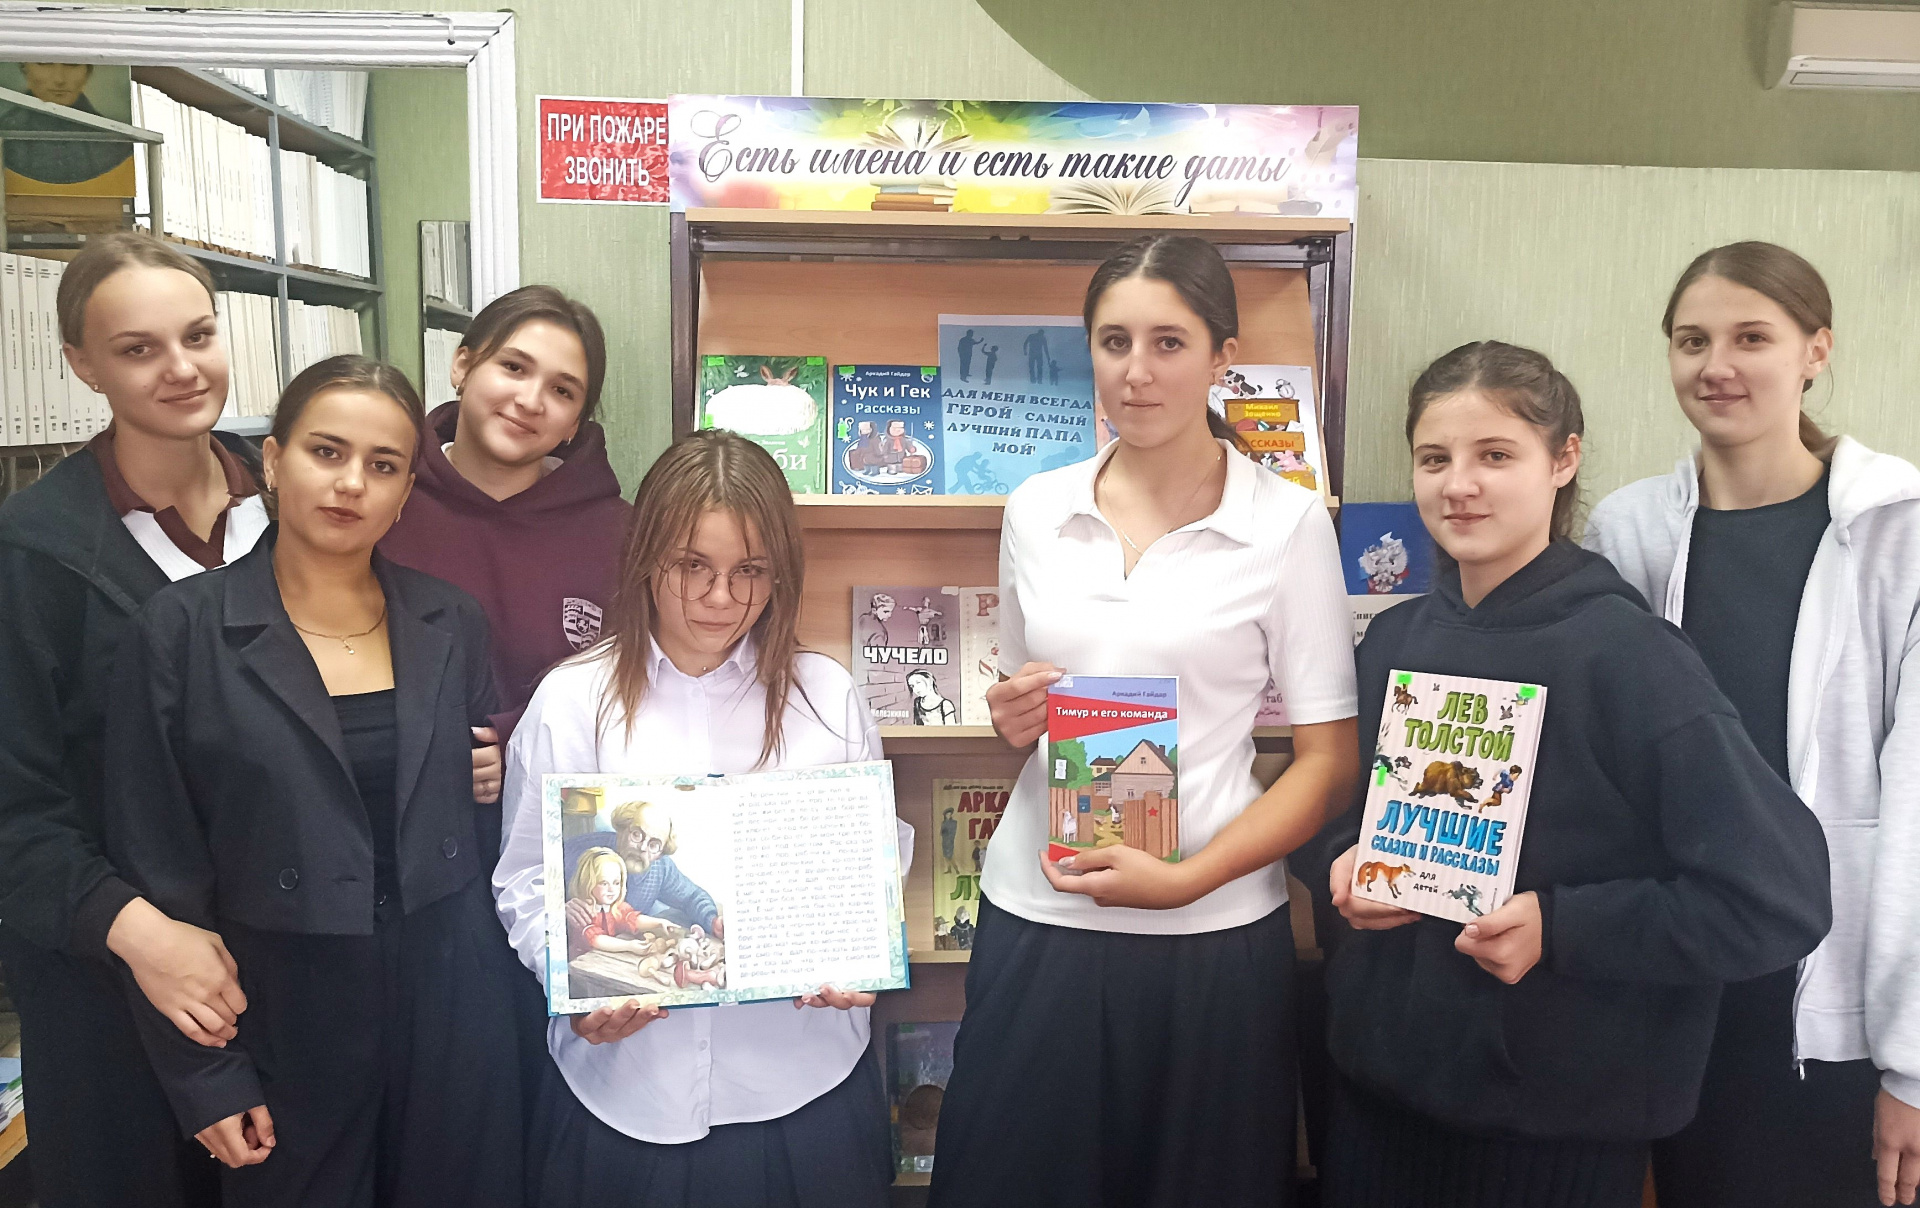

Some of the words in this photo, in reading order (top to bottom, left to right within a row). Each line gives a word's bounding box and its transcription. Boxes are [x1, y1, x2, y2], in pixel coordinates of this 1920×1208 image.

[547, 113, 584, 143] ПРИ
[590, 115, 667, 145] ПОЖАРЕ
[691, 110, 799, 183] Есть
[809, 147, 931, 175] имена
[940, 150, 966, 175] и
[974, 150, 1051, 178] есть
[1059, 151, 1177, 180] такие
[1175, 152, 1291, 207] даты
[565, 156, 650, 186] ЗВОНИТЬ
[845, 384, 879, 400] Чук
[883, 386, 895, 397] и
[900, 384, 931, 399] Гек
[942, 387, 978, 399] ДЛЯ
[981, 391, 1026, 404] МЕНЯ
[1029, 396, 1093, 410] ВСЕГДА
[855, 403, 920, 415] Рассказы
[946, 402, 1013, 420] ГЕРОЙ
[1025, 412, 1087, 426] САМЫЙ
[947, 422, 1022, 438] ЛУЧШИЙ
[1025, 427, 1083, 443] ПАПА
[1250, 439, 1295, 448] ССКАЗЫ
[992, 441, 1036, 456] МОЙ!
[863, 646, 949, 665] ЧУЧЕЛО
[1056, 706, 1089, 719] Тимур
[1101, 710, 1118, 718] его
[1120, 710, 1168, 721] команда
[1437, 691, 1489, 725] ЛЕВ
[1404, 718, 1515, 762] ТОЛСТОЙ
[957, 791, 1010, 813] АРКА
[1376, 800, 1507, 856] ЛУЧШИЕ
[1371, 834, 1417, 859] СКАЗКИ
[1418, 844, 1429, 861] И
[1429, 846, 1500, 876] РАССКАЗЫ
[1413, 883, 1439, 894] детей
